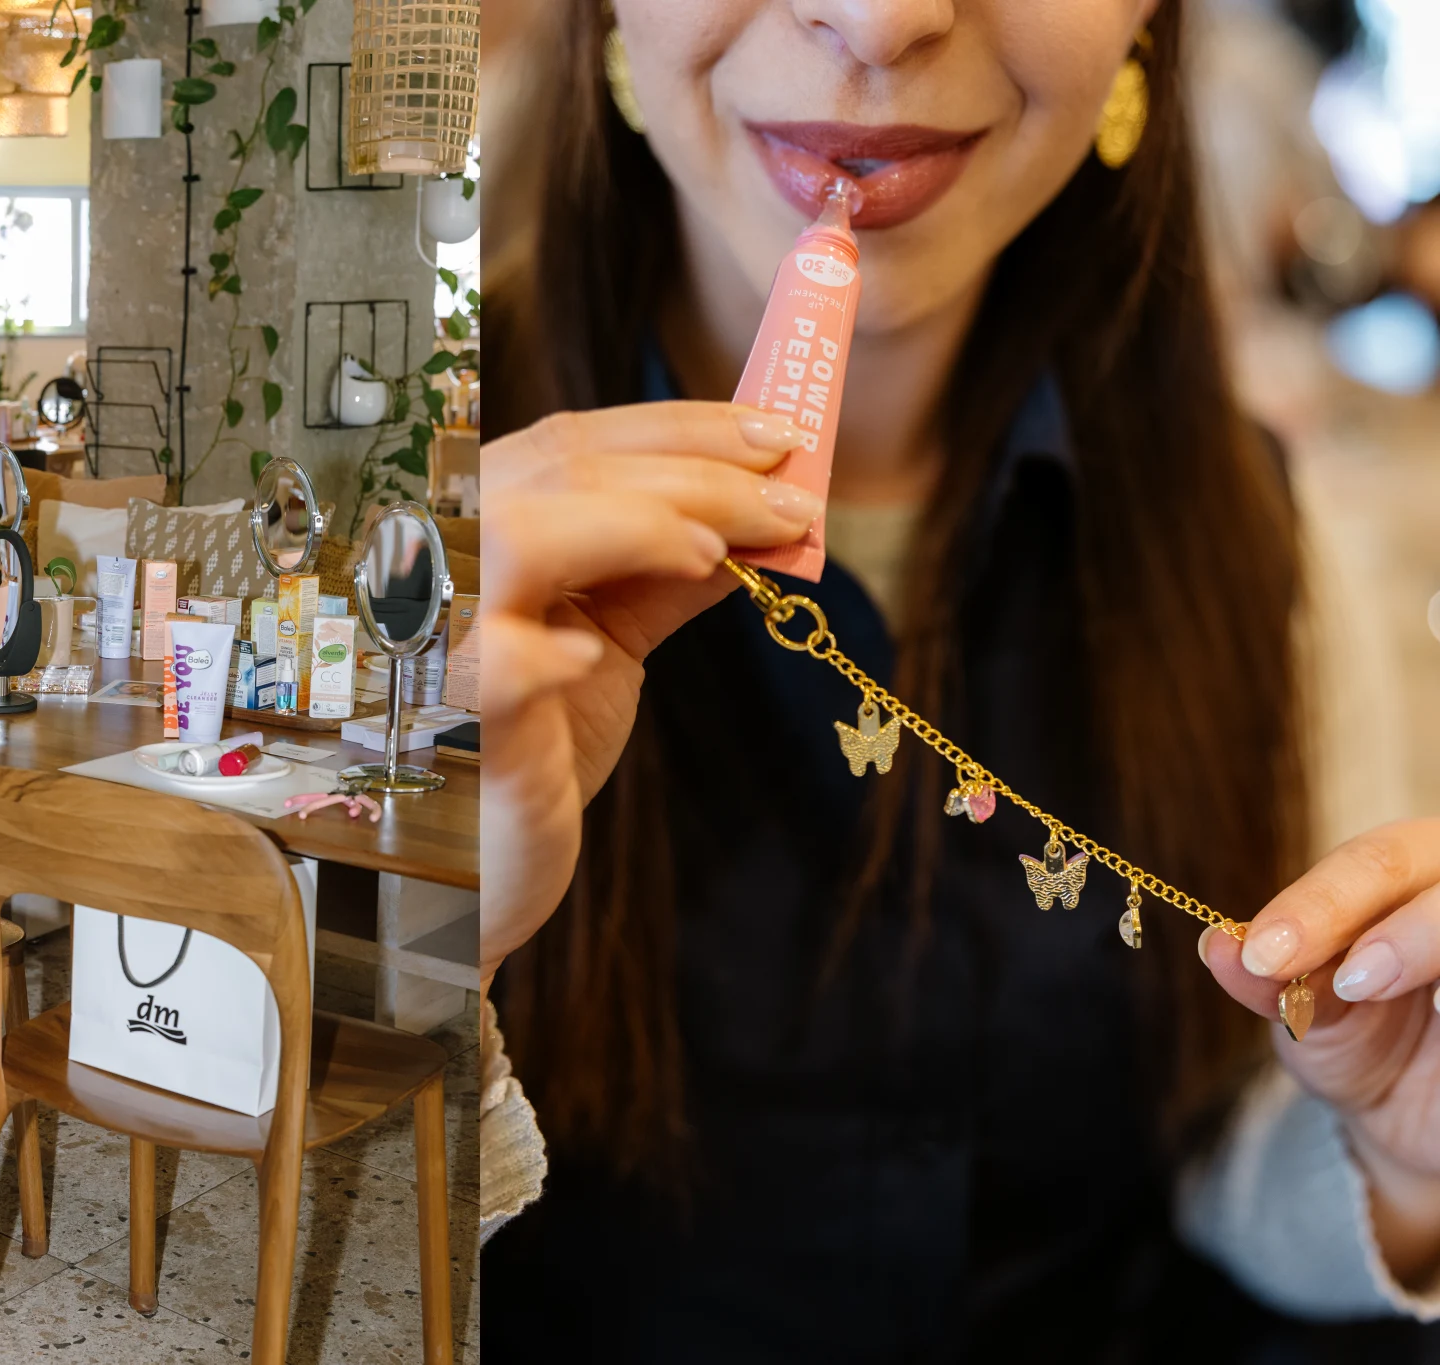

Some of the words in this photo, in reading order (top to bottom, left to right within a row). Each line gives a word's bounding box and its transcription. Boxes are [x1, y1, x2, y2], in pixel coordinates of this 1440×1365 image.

[802, 259, 825, 274] 30
[828, 264, 849, 281] SPF
[809, 301, 824, 311] LIP
[764, 340, 781, 384] COTTON
[771, 317, 817, 425] PEPTI
[757, 386, 770, 409] CAN
[799, 336, 839, 453] POWER
[280, 624, 294, 632] Balea
[176, 644, 194, 691] YOU
[188, 655, 210, 665] Balea
[228, 671, 240, 679] alea
[321, 670, 342, 683] CC
[186, 694, 218, 702] CLEANSER
[176, 700, 190, 730] BE
[136, 994, 180, 1028] dm
